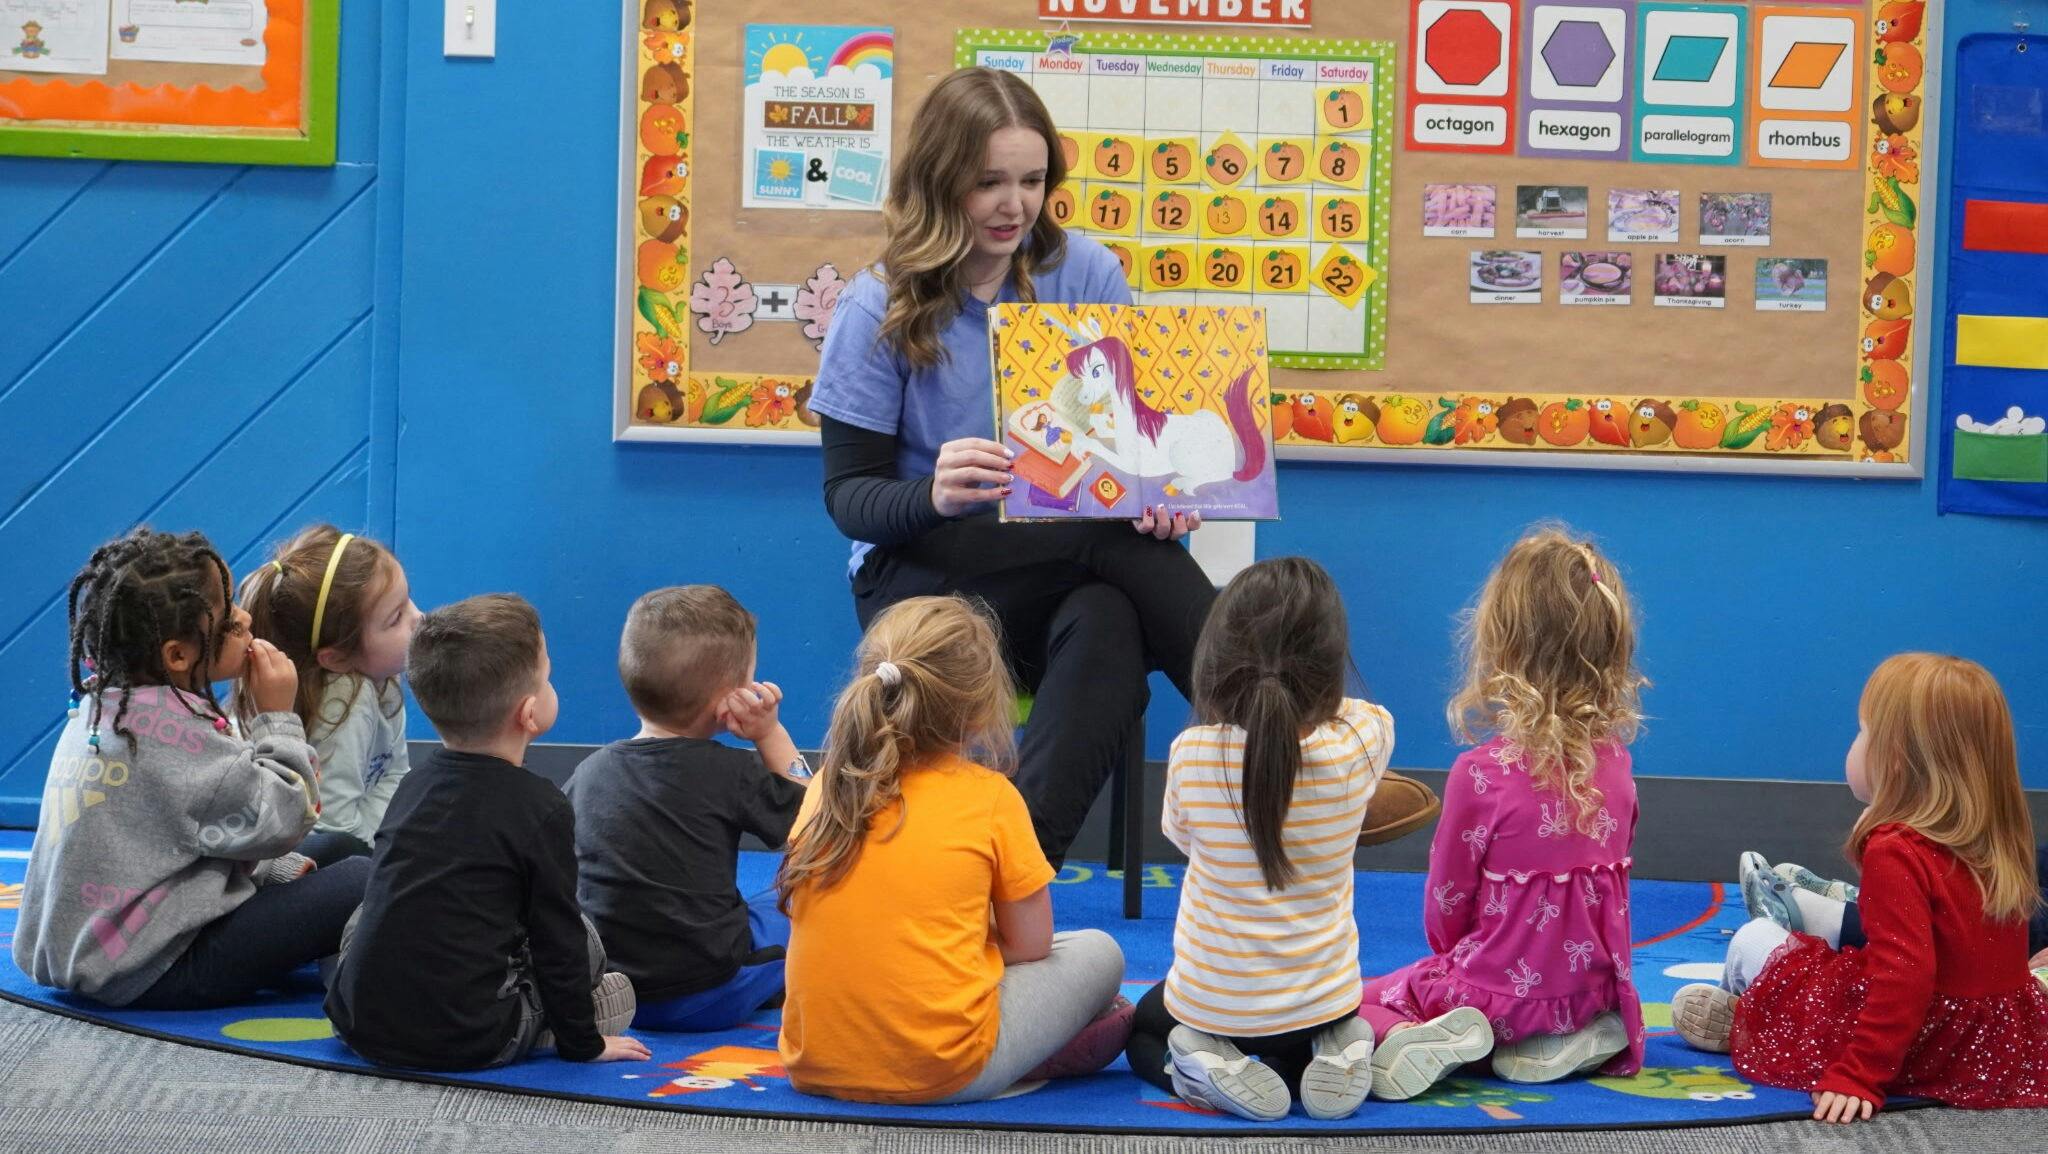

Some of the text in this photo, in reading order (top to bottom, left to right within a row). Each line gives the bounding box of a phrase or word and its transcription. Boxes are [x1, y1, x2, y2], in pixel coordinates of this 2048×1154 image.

[985, 56, 1368, 81] Sunday Monday Tuesday Wednesday Thursday Friday Saturday
[774, 86, 865, 99] THE SEASON IS
[790, 106, 848, 126] FALL
[1337, 105, 1349, 123] 1
[1426, 116, 1494, 137] octagon
[1538, 121, 1611, 142] hexagon
[767, 136, 870, 148] THE WEATHER IS
[1644, 128, 1731, 146] parallelogram
[1768, 131, 1840, 148] rhombus
[806, 158, 828, 182] &
[1107, 154, 1120, 172] 4
[1166, 157, 1178, 175] 5
[1222, 158, 1239, 175] 6
[1278, 157, 1291, 175] 7
[1332, 157, 1346, 176] 8
[836, 166, 873, 186] COOL
[759, 185, 799, 196] SUNNY
[1055, 201, 1068, 219] 0
[1098, 205, 1121, 225] 11
[1157, 206, 1182, 225] 12
[1216, 210, 1231, 224] 13
[1266, 212, 1291, 231] 14
[1328, 213, 1353, 232] 15
[1155, 262, 1182, 281] 19
[1211, 263, 1239, 282] 20
[1269, 265, 1294, 284] 21
[1325, 267, 1354, 293] 22
[1667, 298, 1712, 306] Thanksgiving
